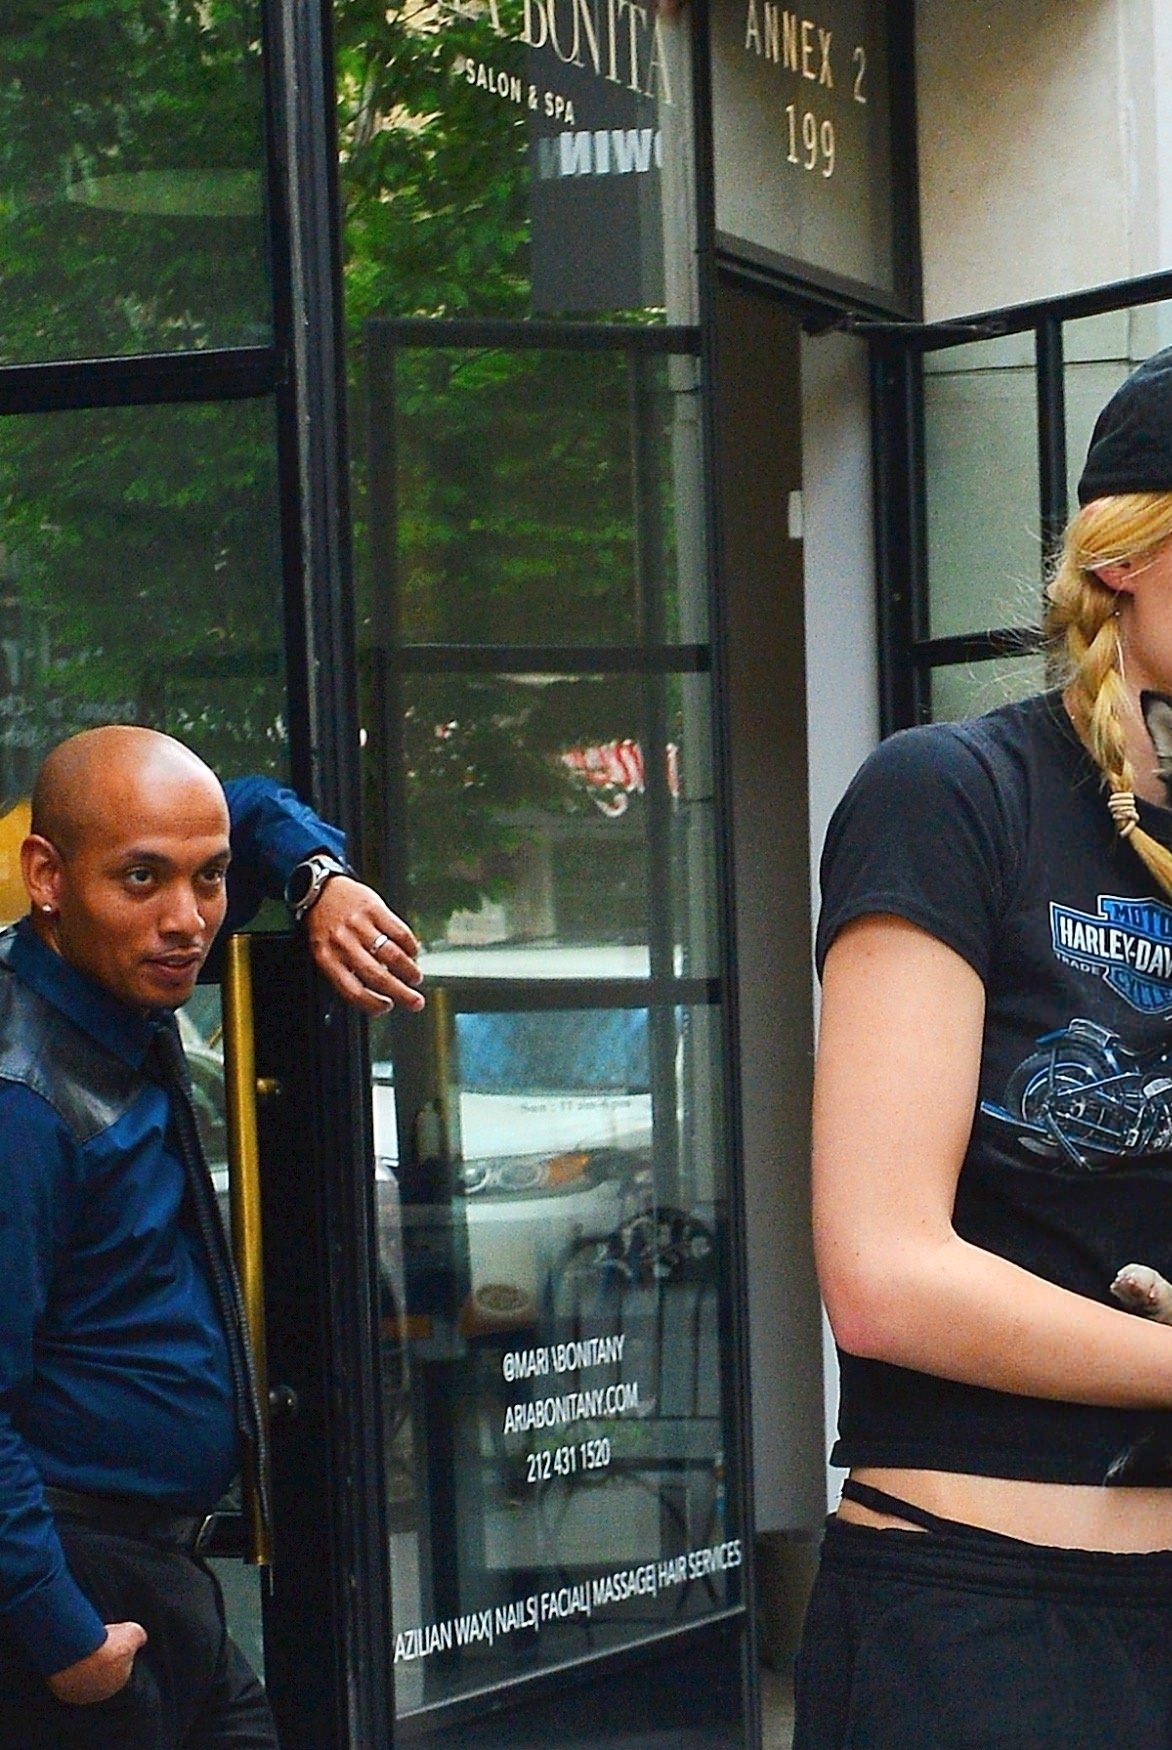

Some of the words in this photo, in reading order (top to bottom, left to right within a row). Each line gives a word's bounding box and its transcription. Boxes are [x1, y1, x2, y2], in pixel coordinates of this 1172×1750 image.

[745, 0, 834, 88] ANNEX
[852, 46, 867, 103] 2
[465, 58, 522, 104] SALON
[528, 84, 539, 111] &
[544, 92, 576, 126] SPA
[785, 104, 836, 178] 199
[526, 1451, 551, 1484] 212
[554, 1445, 576, 1476] 431
[580, 1437, 611, 1470] 1520
[658, 1555, 688, 1588] HAIR
[687, 1539, 742, 1580] SERVICES
